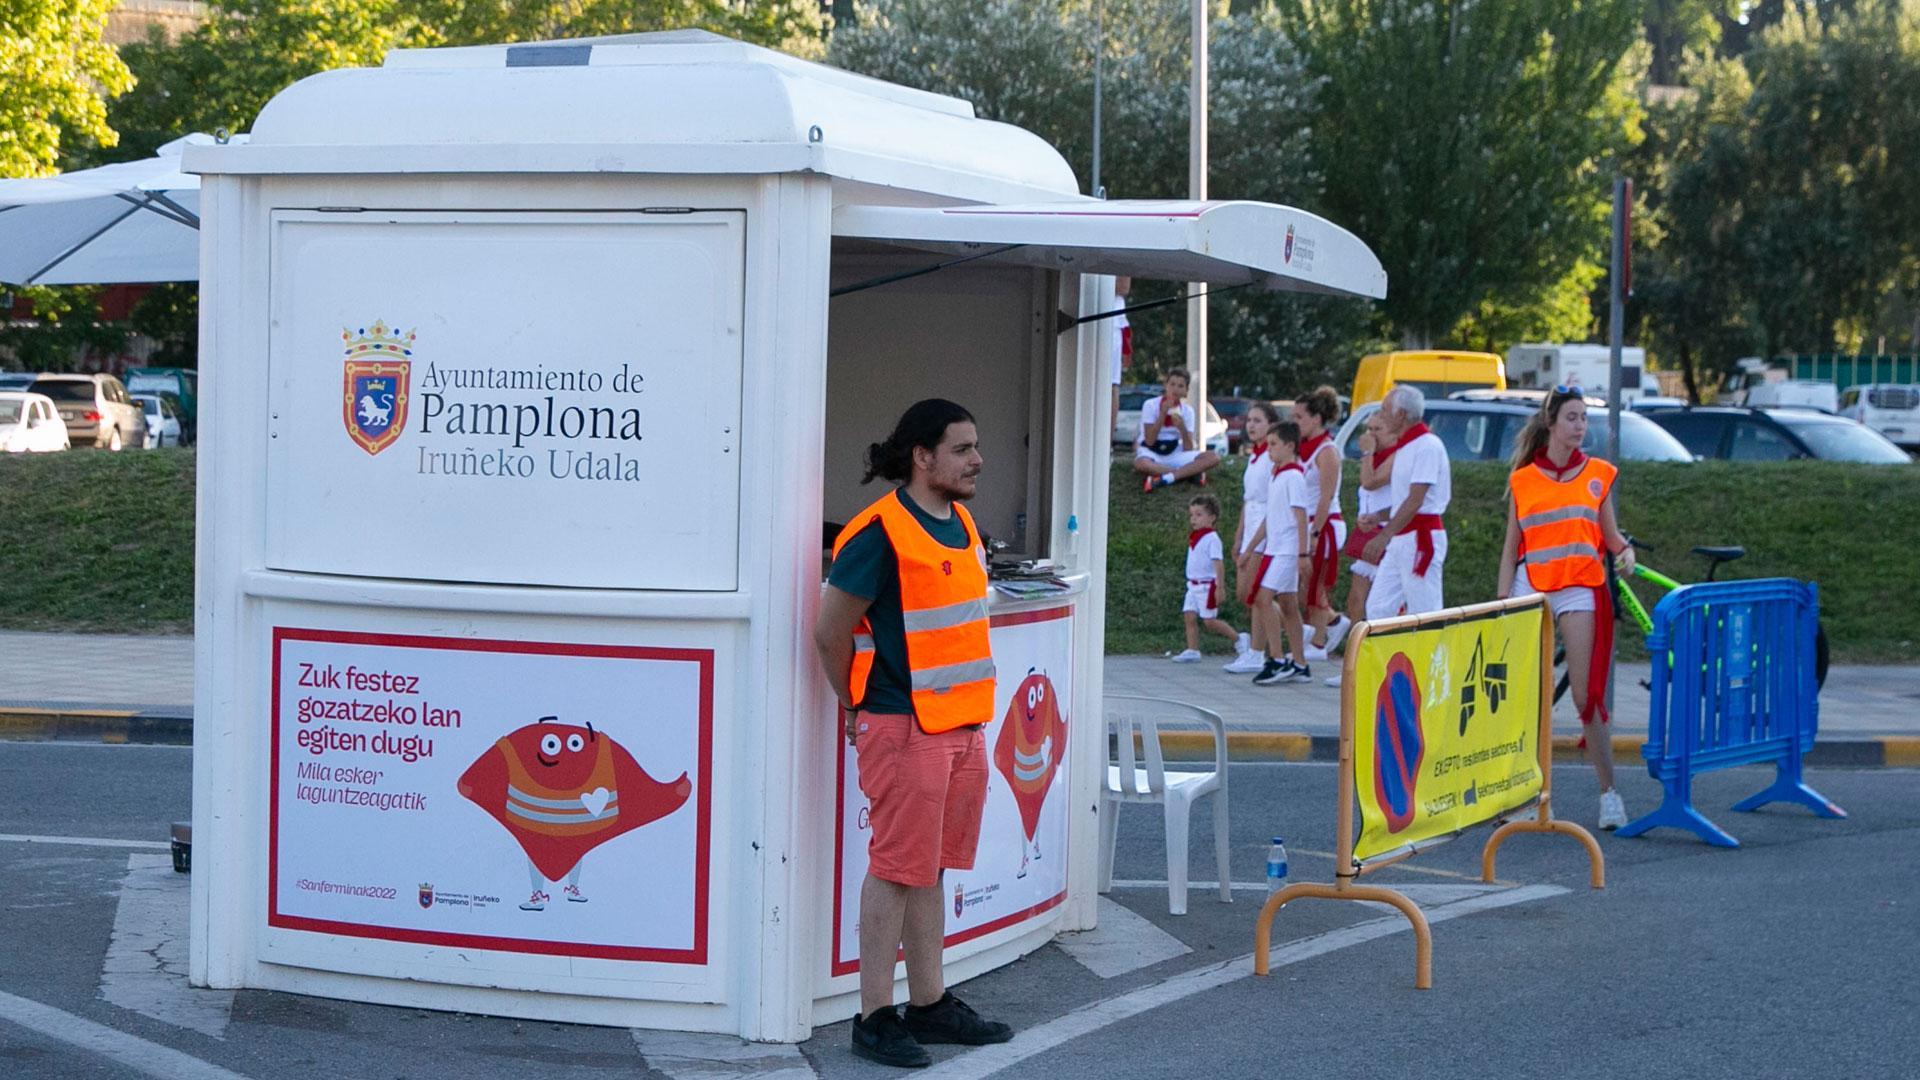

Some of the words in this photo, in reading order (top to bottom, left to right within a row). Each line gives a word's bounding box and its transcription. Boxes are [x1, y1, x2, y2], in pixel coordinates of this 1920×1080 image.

[421, 361, 603, 395] Ayuntamiento
[612, 364, 645, 393] de
[419, 393, 643, 448] Pamplona
[417, 446, 535, 478] Iruñeko
[548, 450, 641, 481] Udala
[298, 662, 341, 690] Zuk
[345, 666, 420, 694] festez
[297, 696, 417, 725] gozatzeko
[422, 701, 461, 728] lan
[297, 725, 366, 755] egiten
[371, 730, 433, 763] dugu
[297, 762, 331, 781] Mila
[334, 766, 384, 785] esker
[296, 783, 427, 811] laguntzeagatik
[296, 879, 397, 900] #Sanferminak2022
[435, 897, 470, 906] Pamplona
